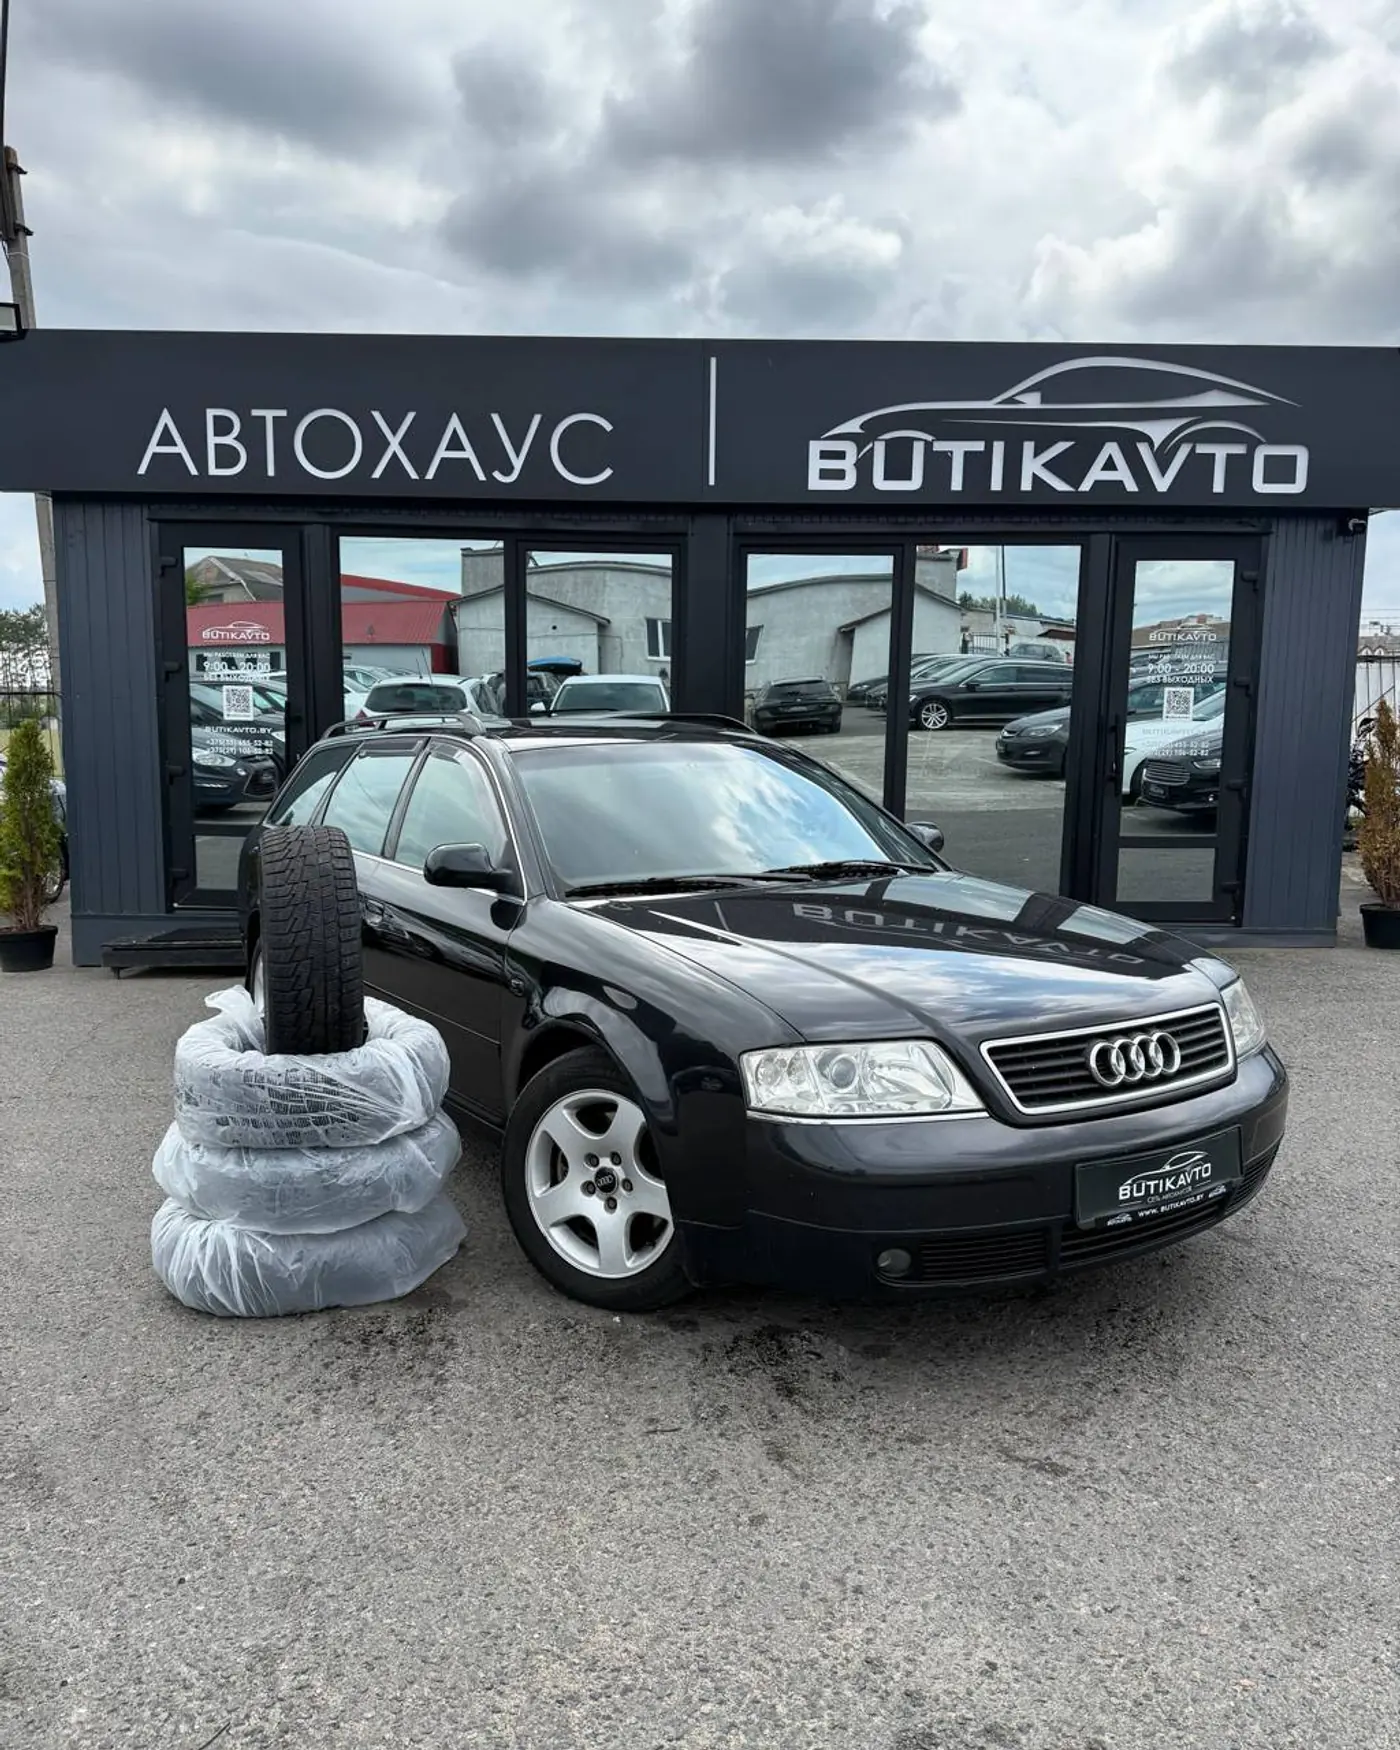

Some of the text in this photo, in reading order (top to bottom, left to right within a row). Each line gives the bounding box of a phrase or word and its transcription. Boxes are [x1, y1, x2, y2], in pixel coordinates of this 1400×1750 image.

[136, 406, 615, 486] АВТОХАУС
[807, 438, 1309, 494] BUTIKAVTO
[202, 631, 270, 641] BUTIKAVTO
[1149, 632, 1217, 641] BUTIKAVTO
[203, 662, 228, 671] 9:00
[239, 662, 271, 672] 20:00
[1148, 663, 1171, 673] 9:00
[1183, 663, 1215, 673] 20:00
[1118, 1163, 1212, 1200] BUTIKAVTO
